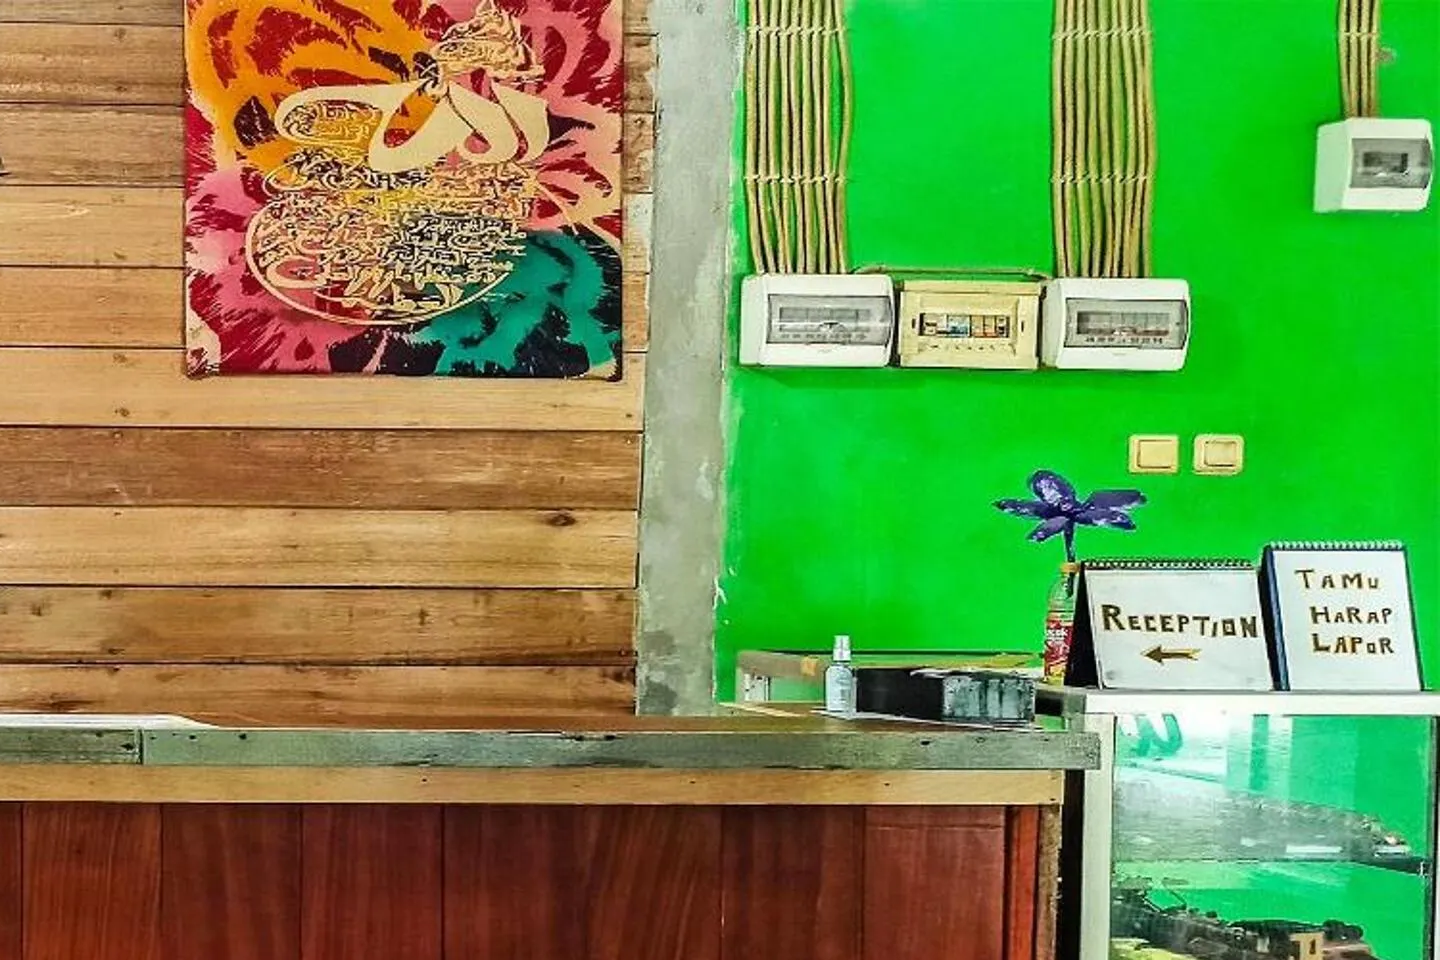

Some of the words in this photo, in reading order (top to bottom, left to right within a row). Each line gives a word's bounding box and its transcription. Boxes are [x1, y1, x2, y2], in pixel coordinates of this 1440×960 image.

[1101, 603, 1259, 639] RECEPTION
[1309, 605, 1394, 625] HARAP
[1311, 632, 1395, 655] LAPOR
